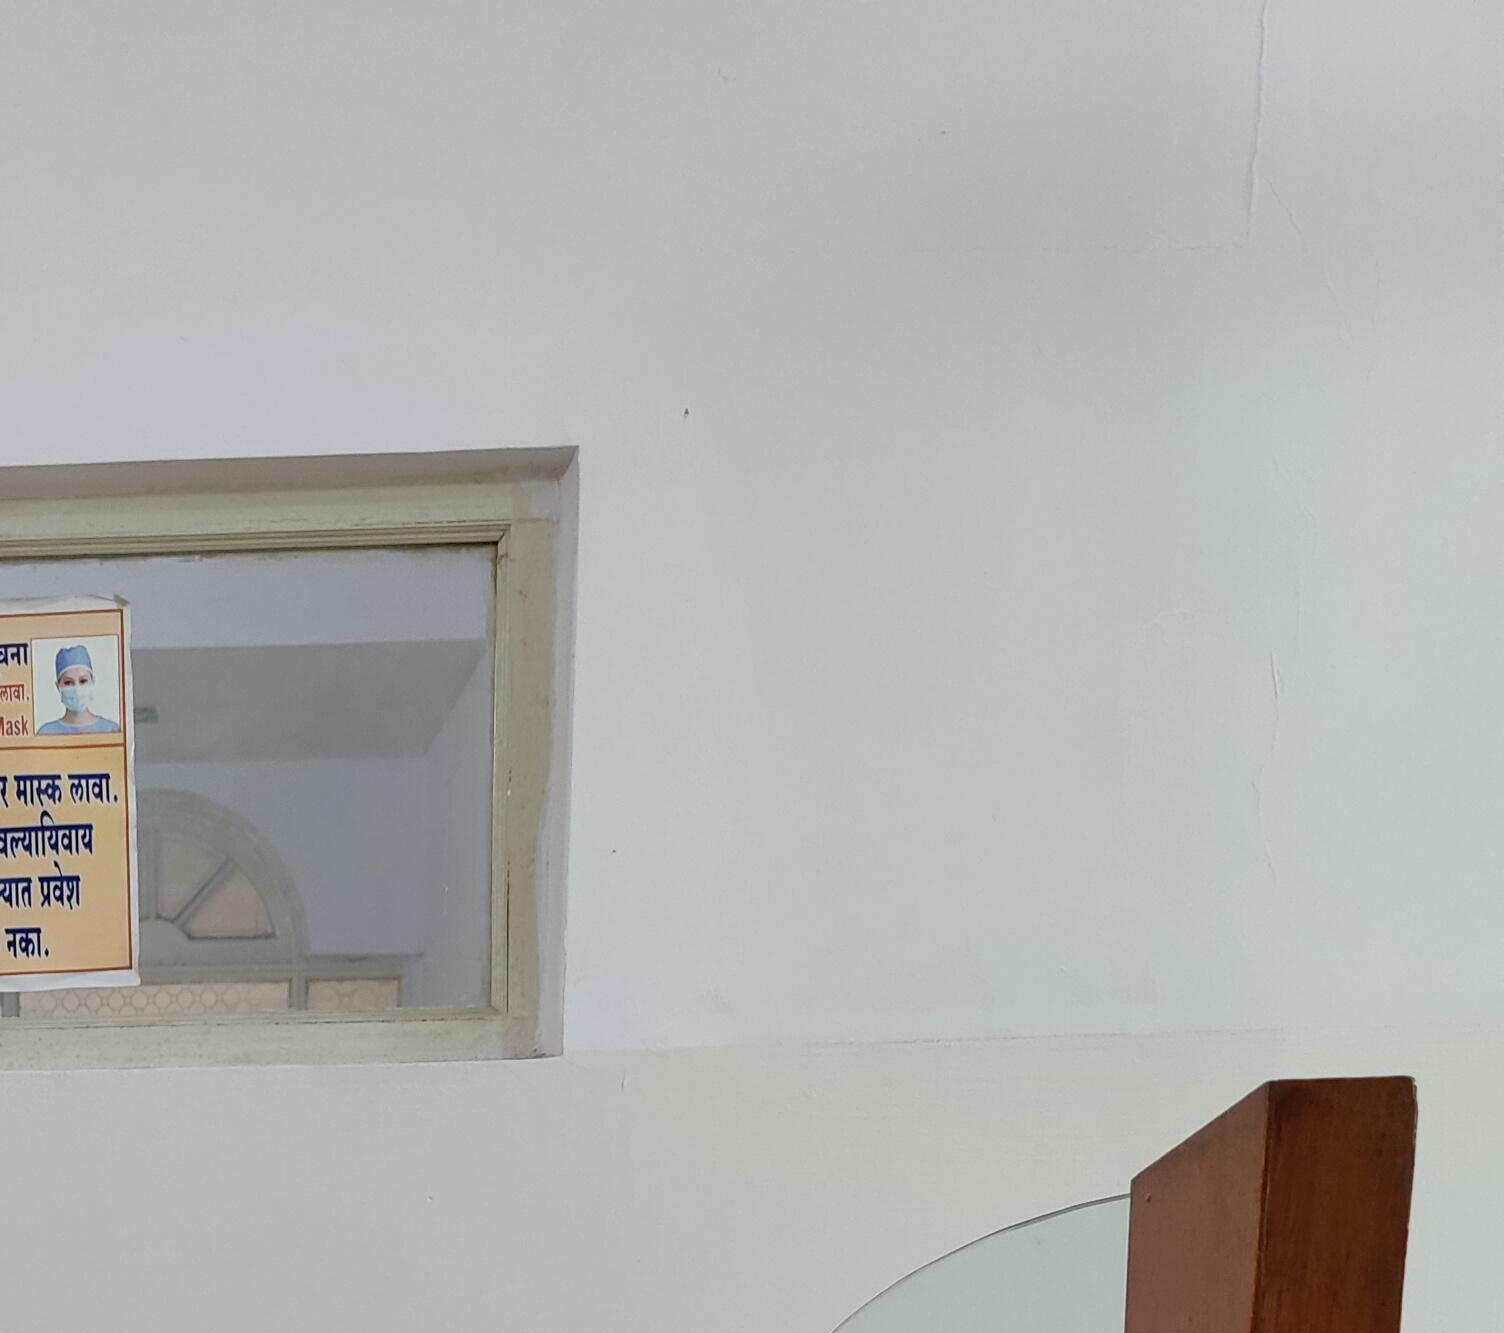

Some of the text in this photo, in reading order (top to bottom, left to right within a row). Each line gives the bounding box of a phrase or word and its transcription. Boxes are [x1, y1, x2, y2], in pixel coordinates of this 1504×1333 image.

[14, 774, 62, 808] मास्क
[67, 773, 119, 804] लावा.
[37, 860, 81, 911] प्रवेश
[4, 926, 50, 959] नका.
